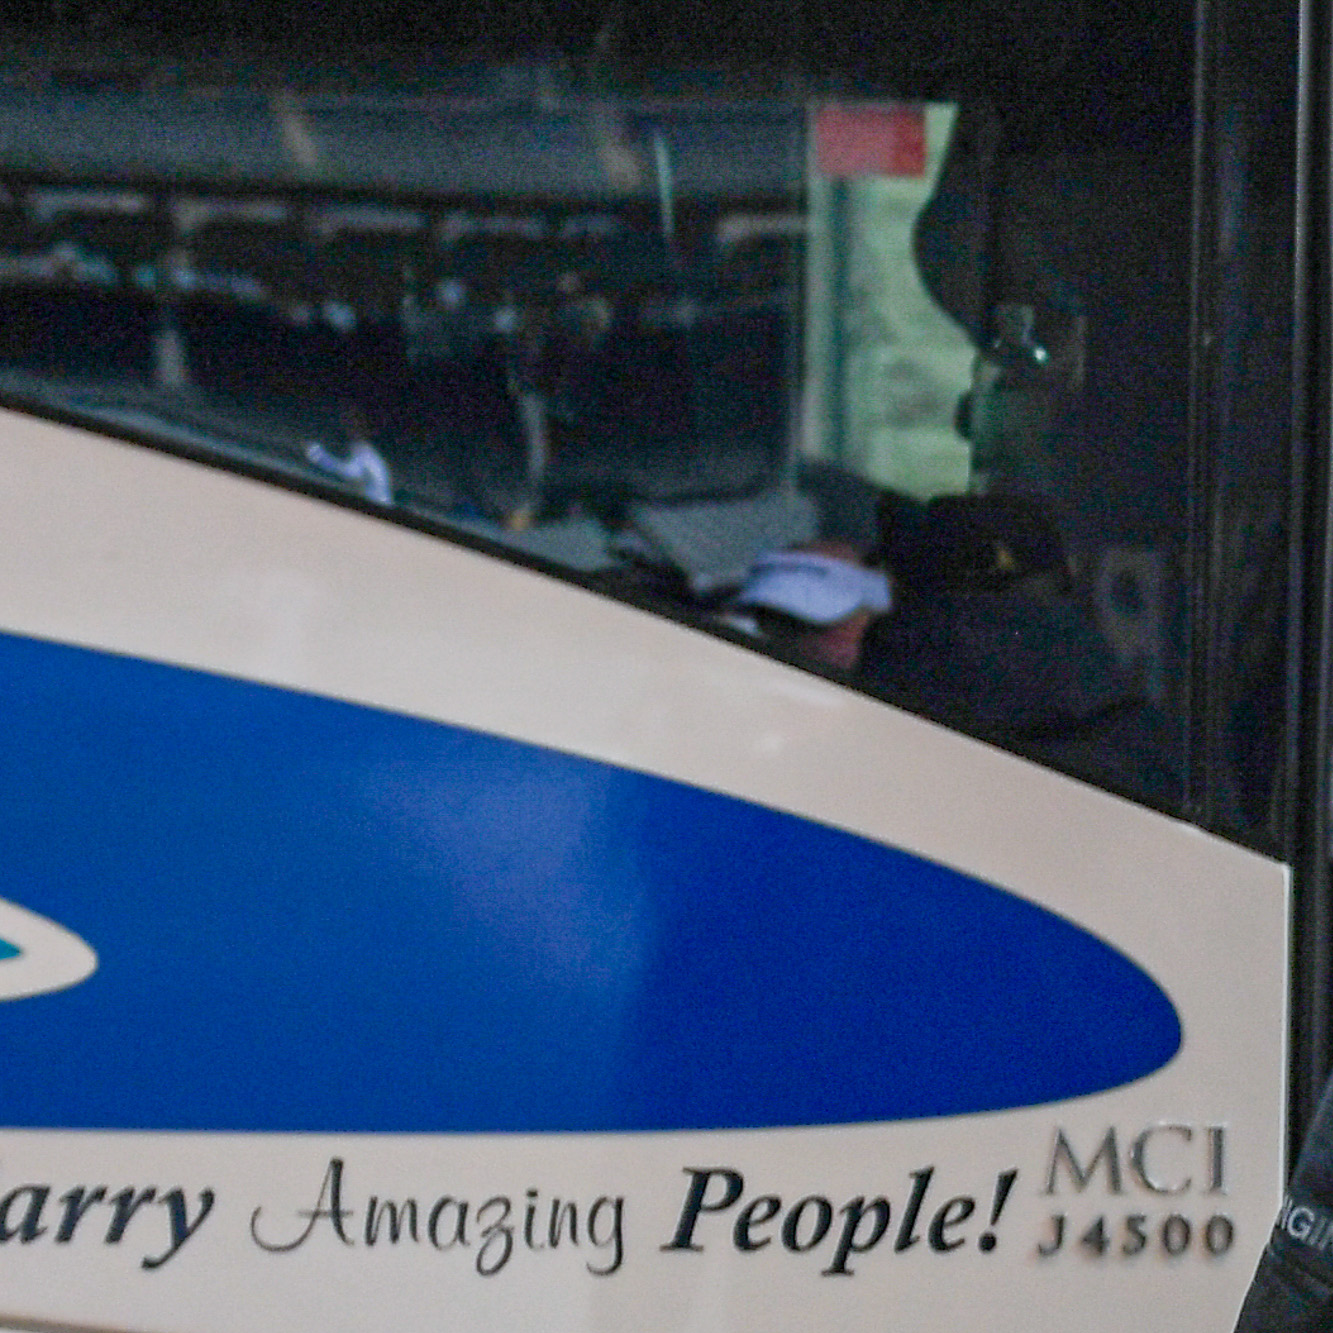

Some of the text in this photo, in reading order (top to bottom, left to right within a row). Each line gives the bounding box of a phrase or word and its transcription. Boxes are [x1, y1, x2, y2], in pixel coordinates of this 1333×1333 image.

[1040, 1125, 1228, 1196] MCI
[250, 1156, 626, 1277] Amazing
[660, 1165, 1018, 1277] People!
[1037, 1213, 1235, 1257] J4500
